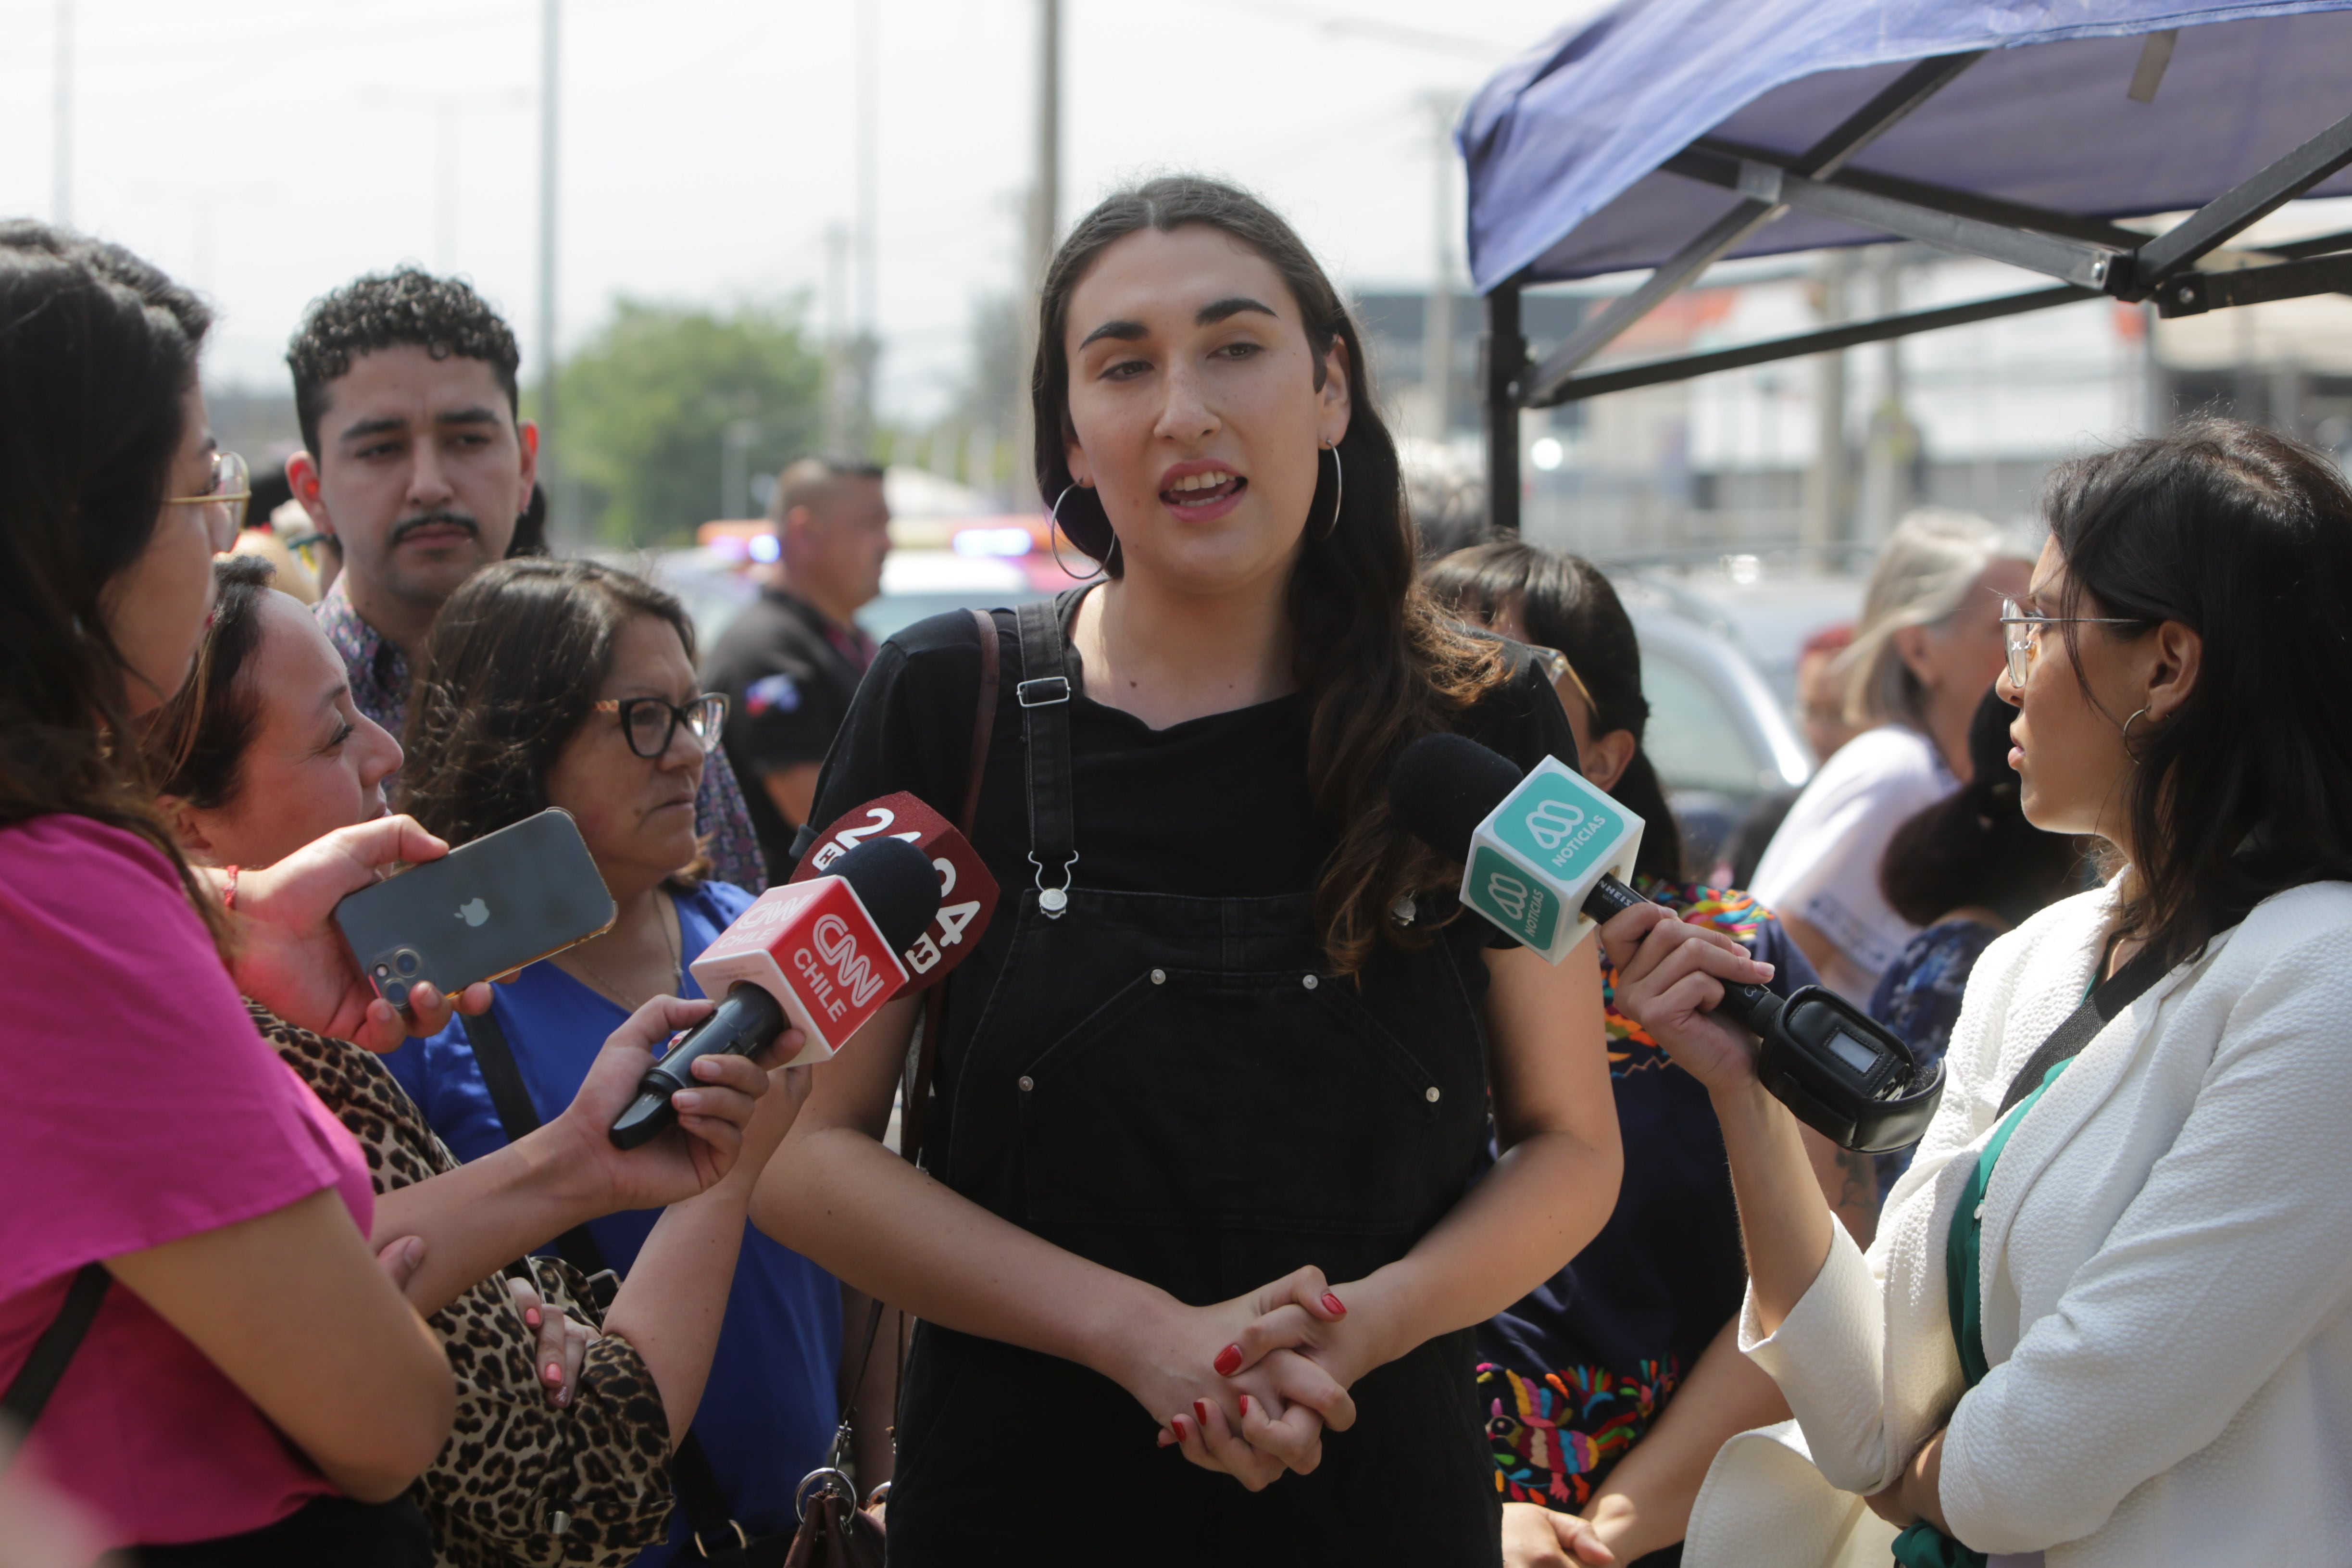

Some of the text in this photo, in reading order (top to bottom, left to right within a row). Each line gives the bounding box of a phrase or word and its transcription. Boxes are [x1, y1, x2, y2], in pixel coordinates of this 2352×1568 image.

[835, 808, 921, 850] 2
[1551, 815, 1606, 867] NOTICIAS
[736, 893, 815, 930] CNN
[1525, 889, 1544, 937] NOTICIAS
[718, 927, 776, 949] CHILE
[813, 914, 885, 1008] CNN
[794, 948, 847, 1023] CHILE
